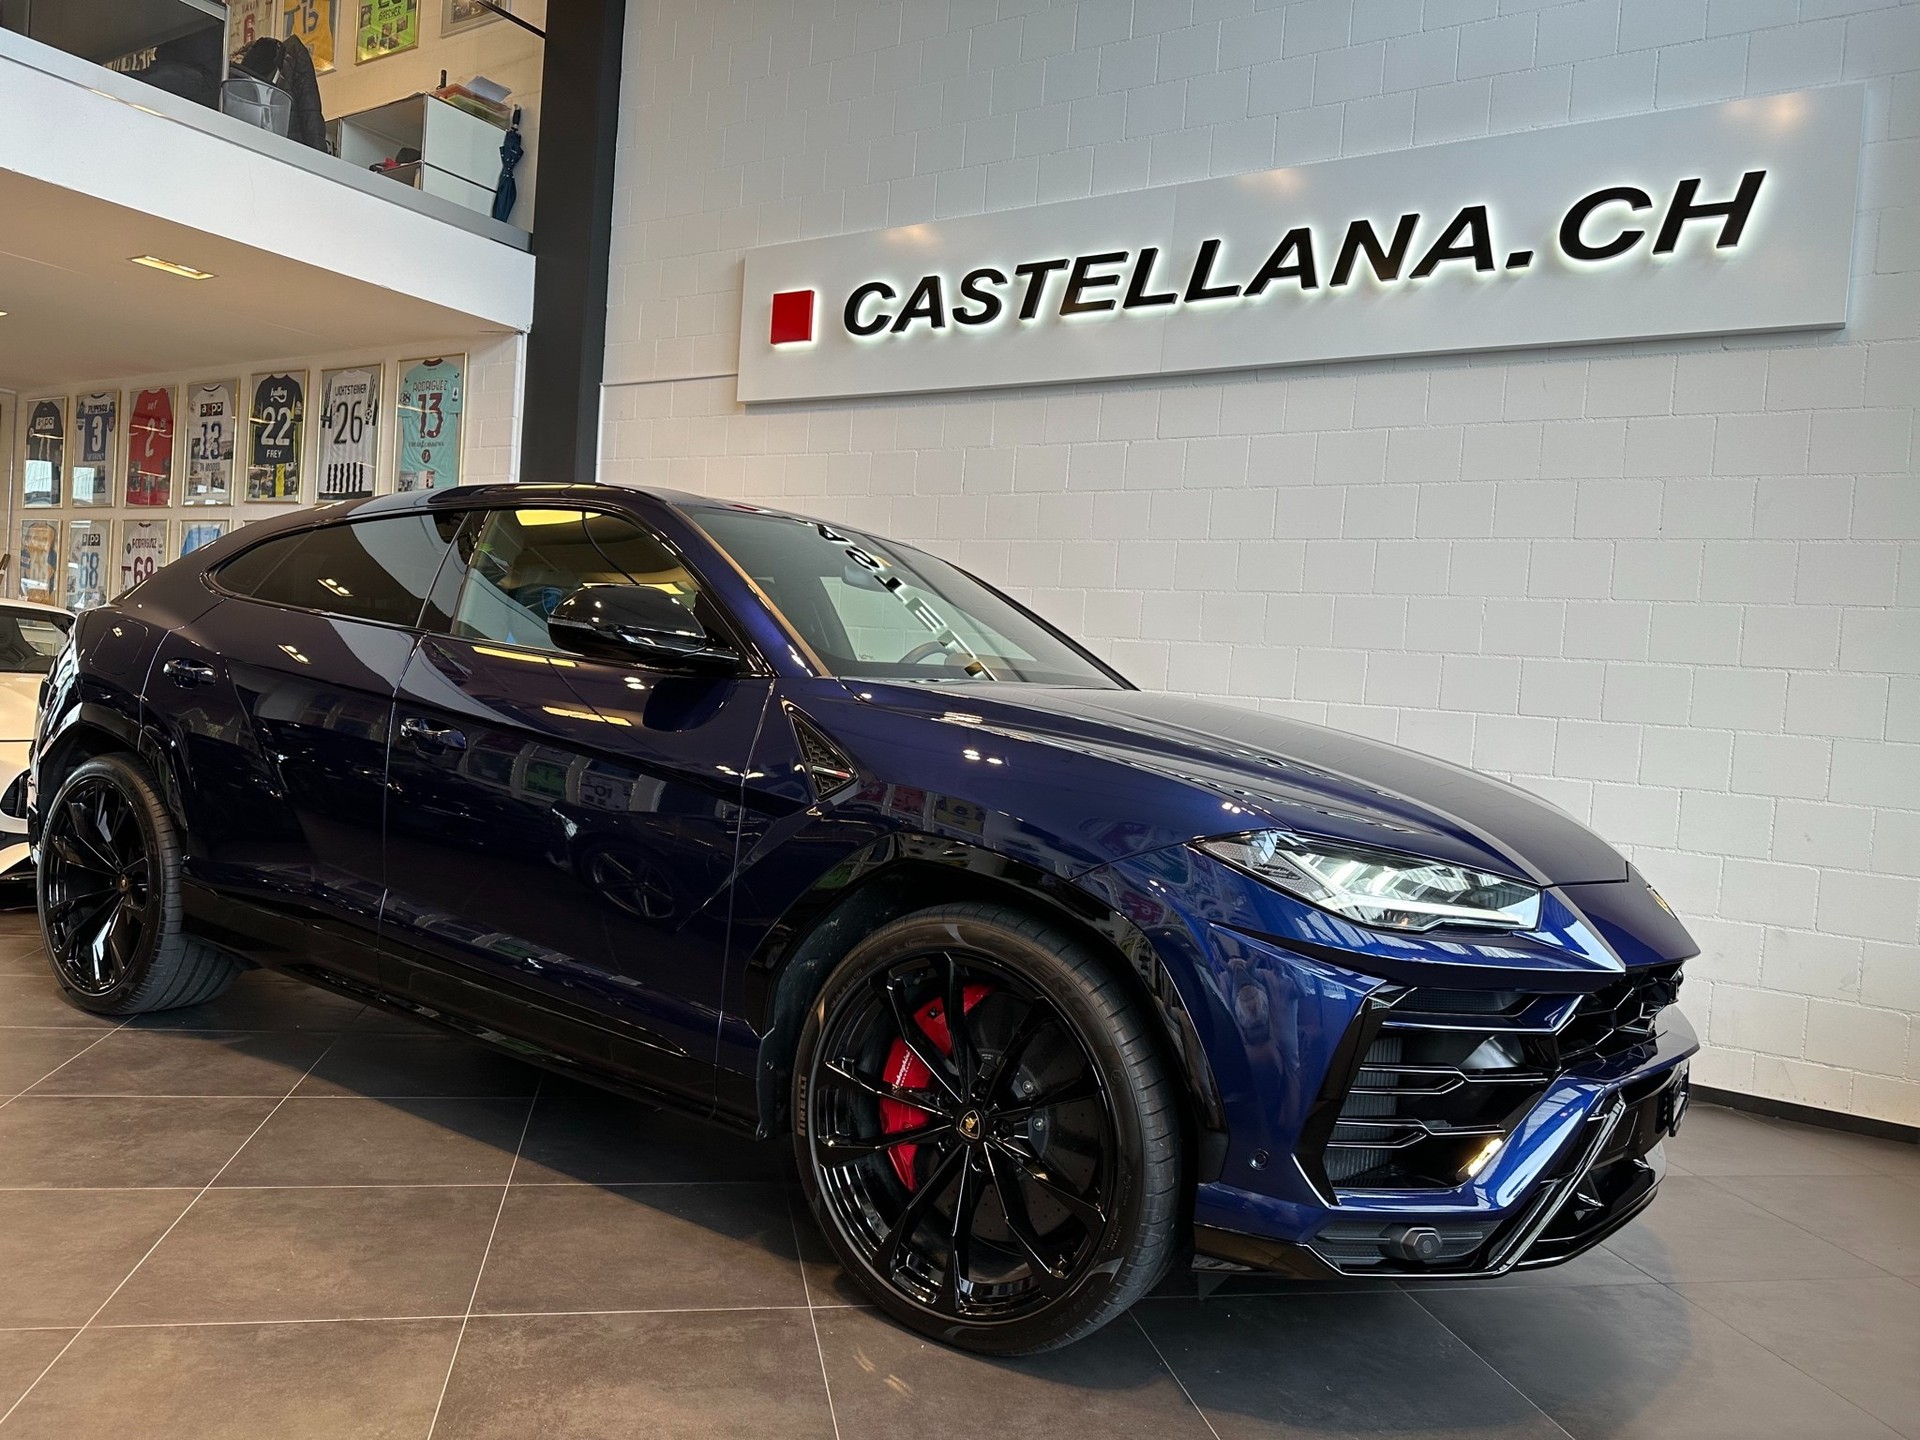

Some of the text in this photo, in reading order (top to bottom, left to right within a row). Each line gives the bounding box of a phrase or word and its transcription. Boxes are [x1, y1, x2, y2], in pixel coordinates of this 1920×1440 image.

[844, 171, 1766, 336] CASTELLANA.CH
[92, 416, 103, 452] 3
[261, 407, 292, 445] 22
[334, 400, 363, 444] 26
[418, 393, 443, 438] 13
[201, 422, 222, 459] 13
[266, 449, 282, 458] FREY
